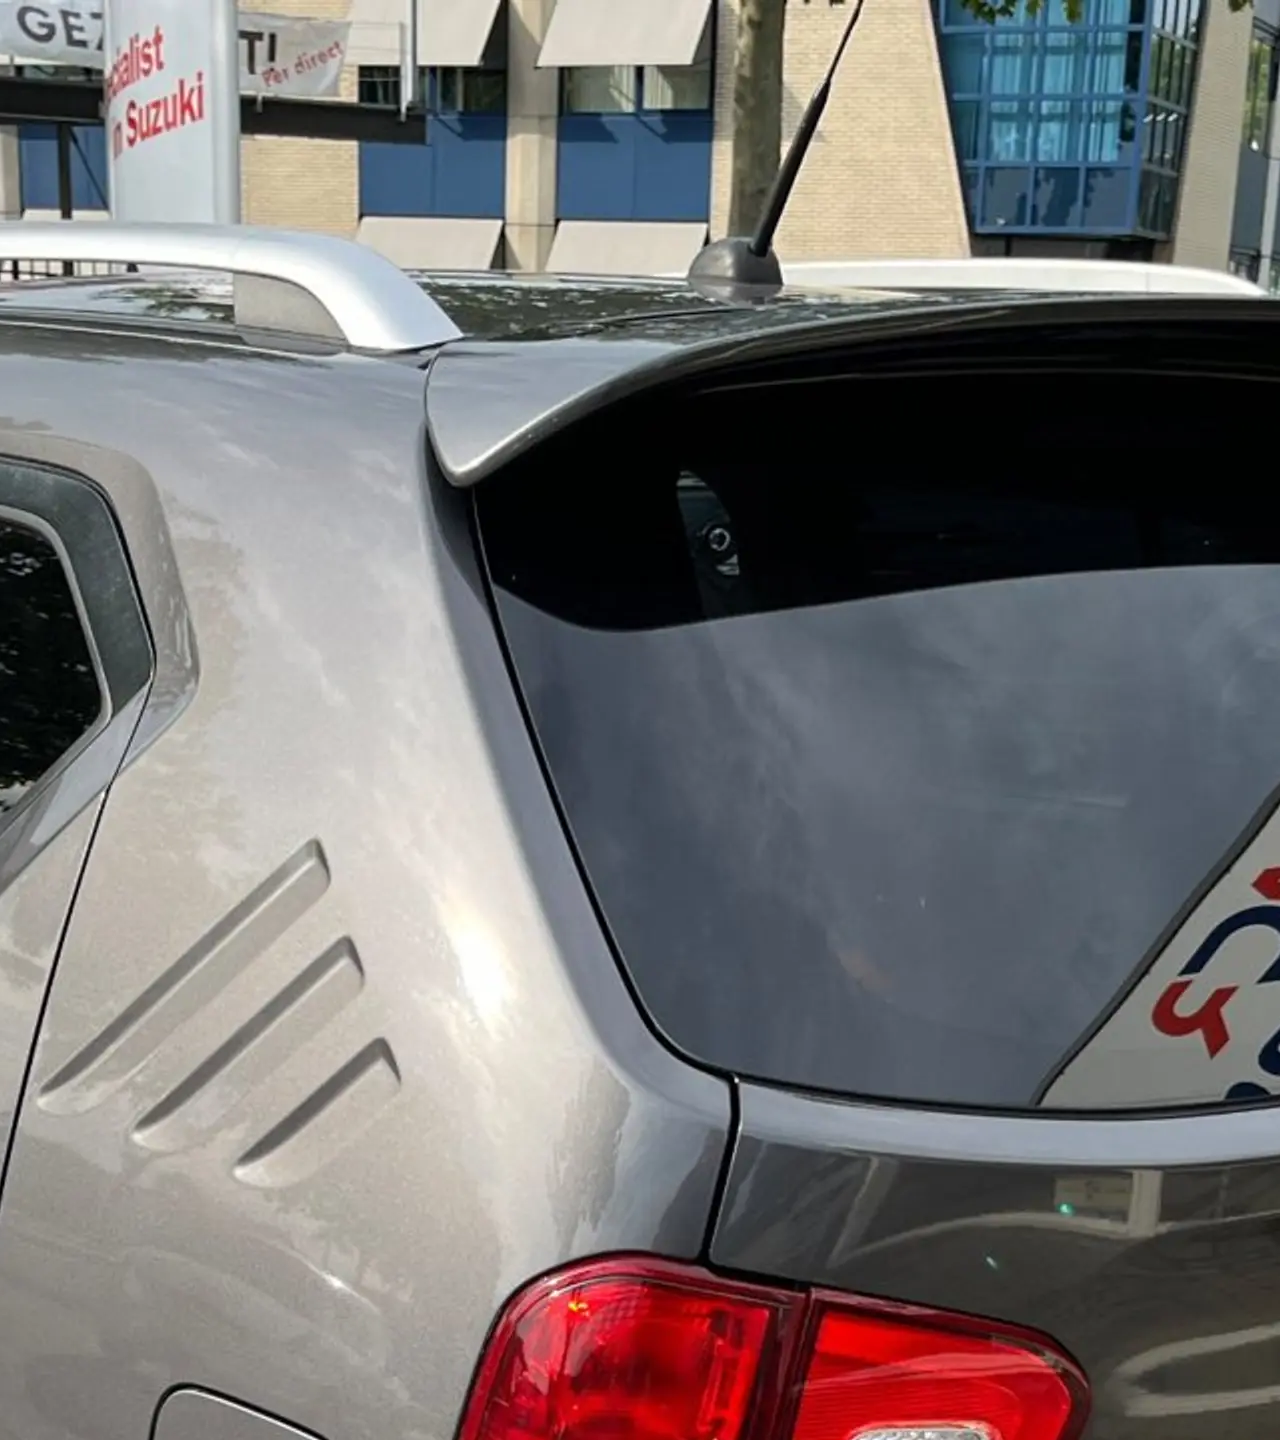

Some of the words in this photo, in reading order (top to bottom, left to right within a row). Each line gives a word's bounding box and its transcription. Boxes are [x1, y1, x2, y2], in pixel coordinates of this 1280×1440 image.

[262, 67, 290, 88] Per
[295, 41, 343, 74] direct
[126, 69, 205, 148] Suzuki
